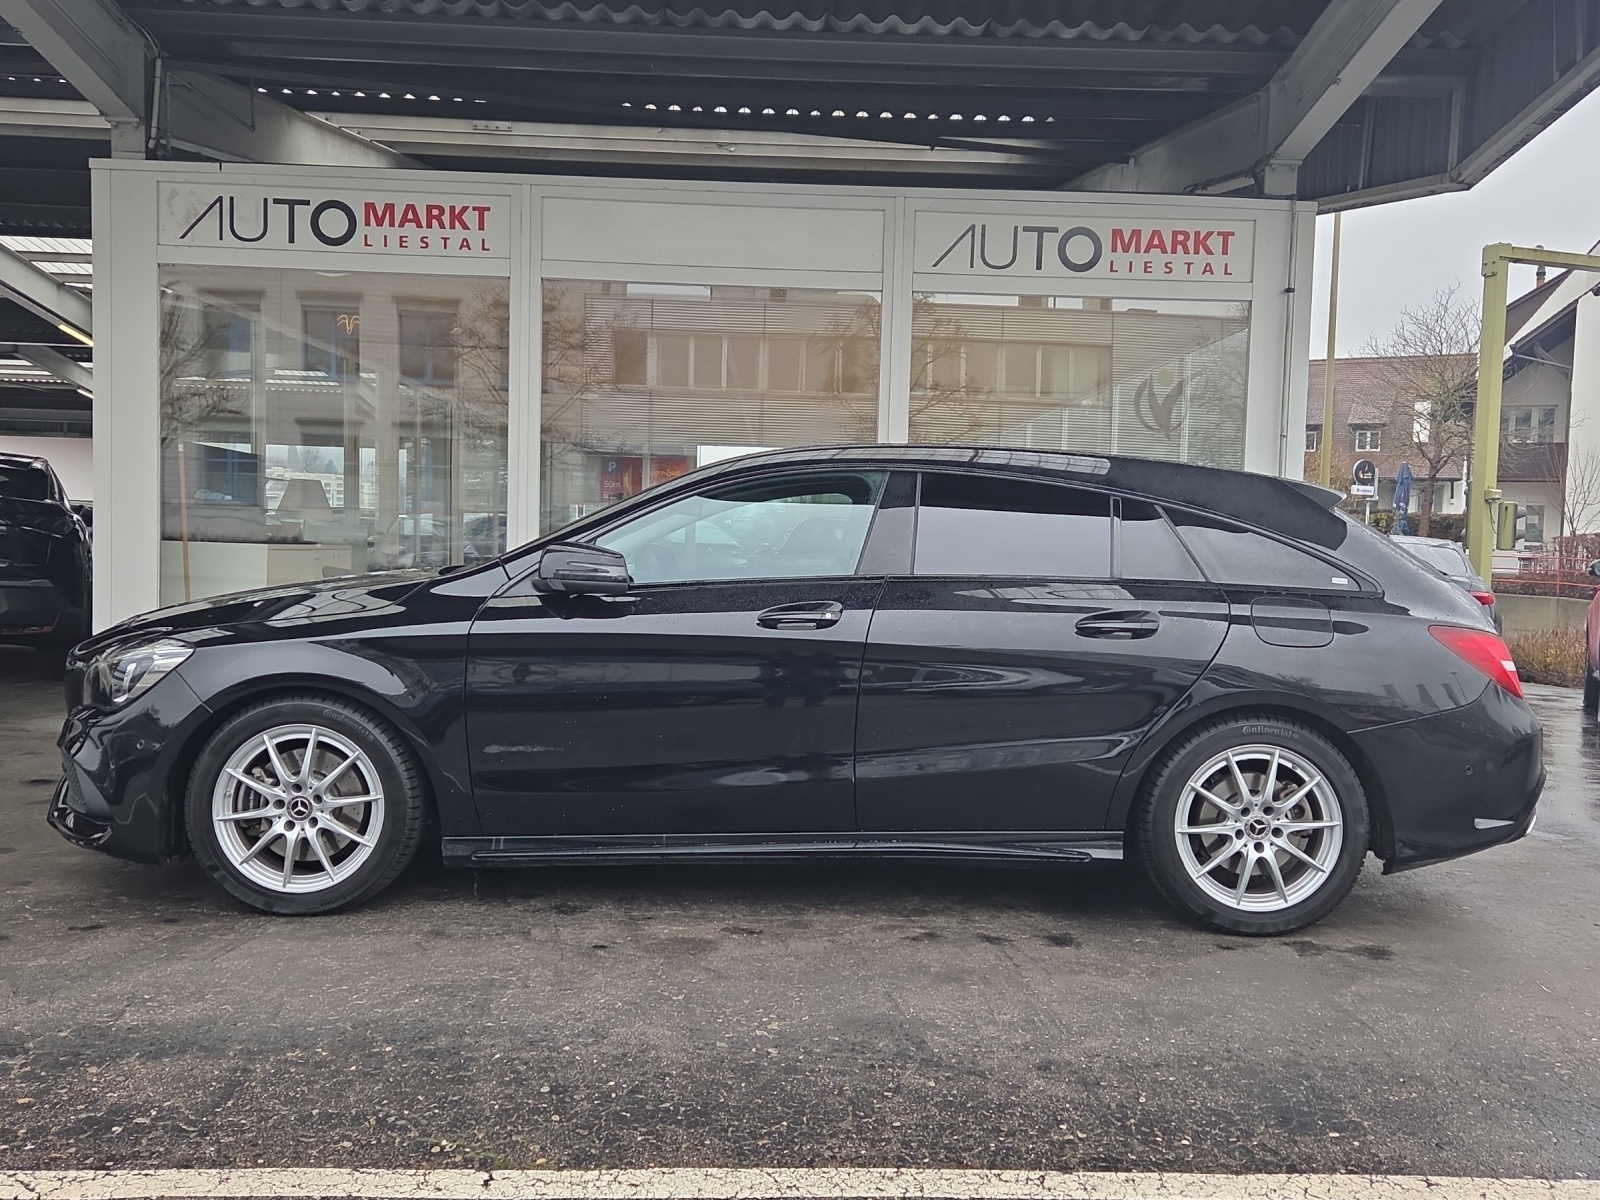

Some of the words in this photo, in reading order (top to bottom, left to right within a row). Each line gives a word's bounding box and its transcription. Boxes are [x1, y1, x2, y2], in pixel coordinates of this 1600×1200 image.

[179, 195, 357, 246] AUTO
[363, 202, 491, 231] MARKT
[363, 234, 491, 251] LIESTAL
[931, 224, 1103, 273] AUTO
[1110, 228, 1236, 256] MARKT
[1109, 260, 1233, 275] LIESTAL
[608, 461, 617, 472] P
[1242, 725, 1293, 738] Continental
